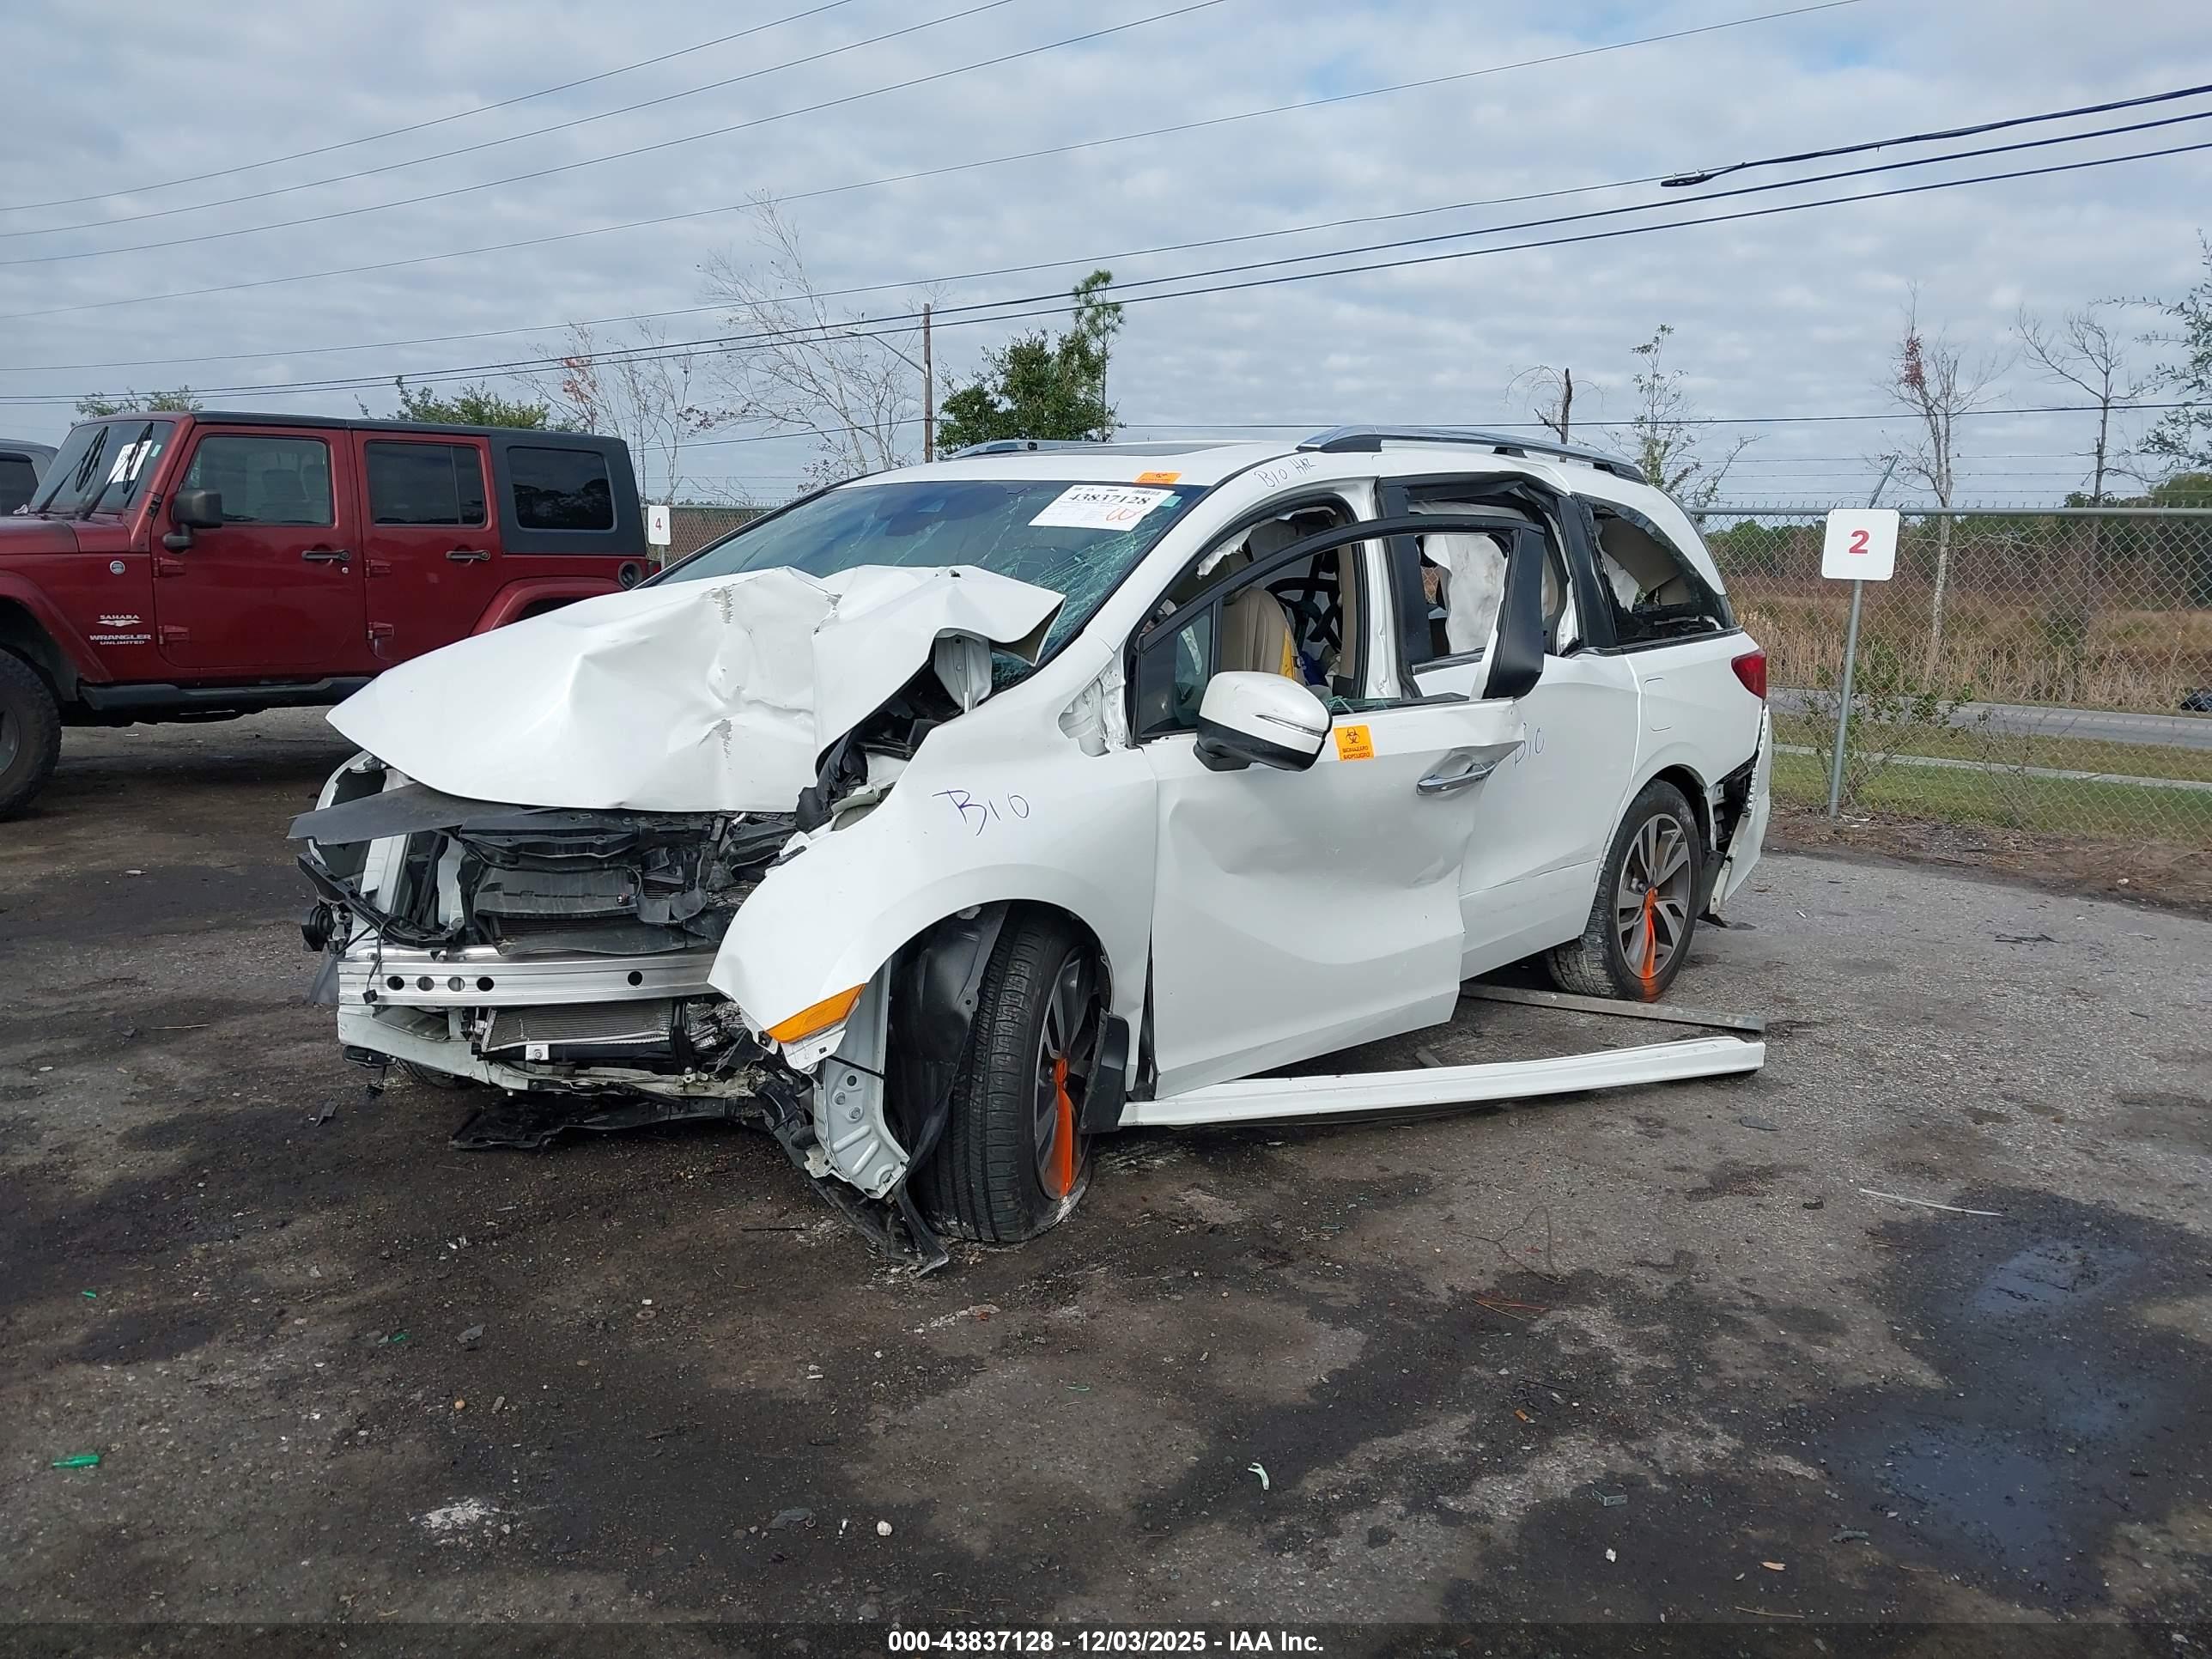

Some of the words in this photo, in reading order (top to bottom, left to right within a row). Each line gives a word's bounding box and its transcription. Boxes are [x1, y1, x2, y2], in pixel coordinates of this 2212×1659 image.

[1254, 469, 1288, 488] BIO
[1069, 494, 1151, 505] 43837128
[655, 517, 663, 531] 4
[1849, 530, 1869, 554] 2
[932, 789, 1030, 836] BIO
